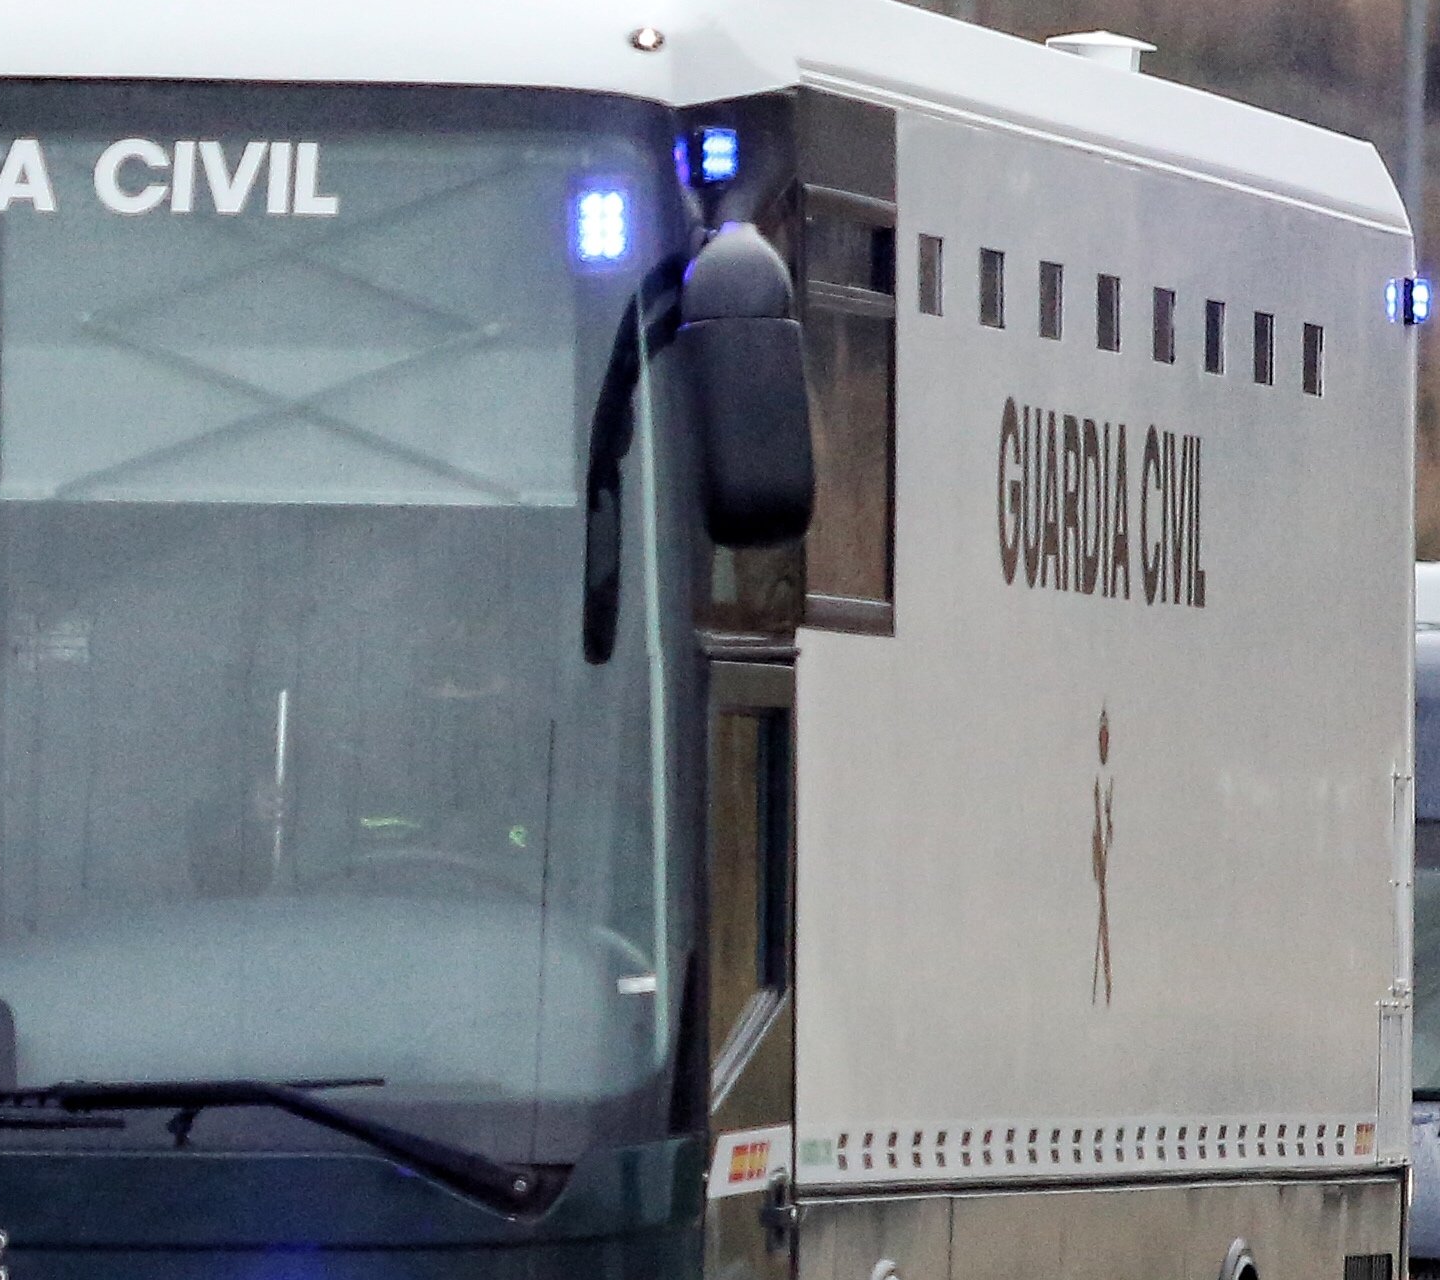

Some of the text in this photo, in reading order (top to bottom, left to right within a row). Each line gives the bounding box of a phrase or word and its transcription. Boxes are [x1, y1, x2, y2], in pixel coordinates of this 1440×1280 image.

[92, 138, 339, 217] CIVIL
[998, 396, 1207, 608] GUARDIA CIVIL
